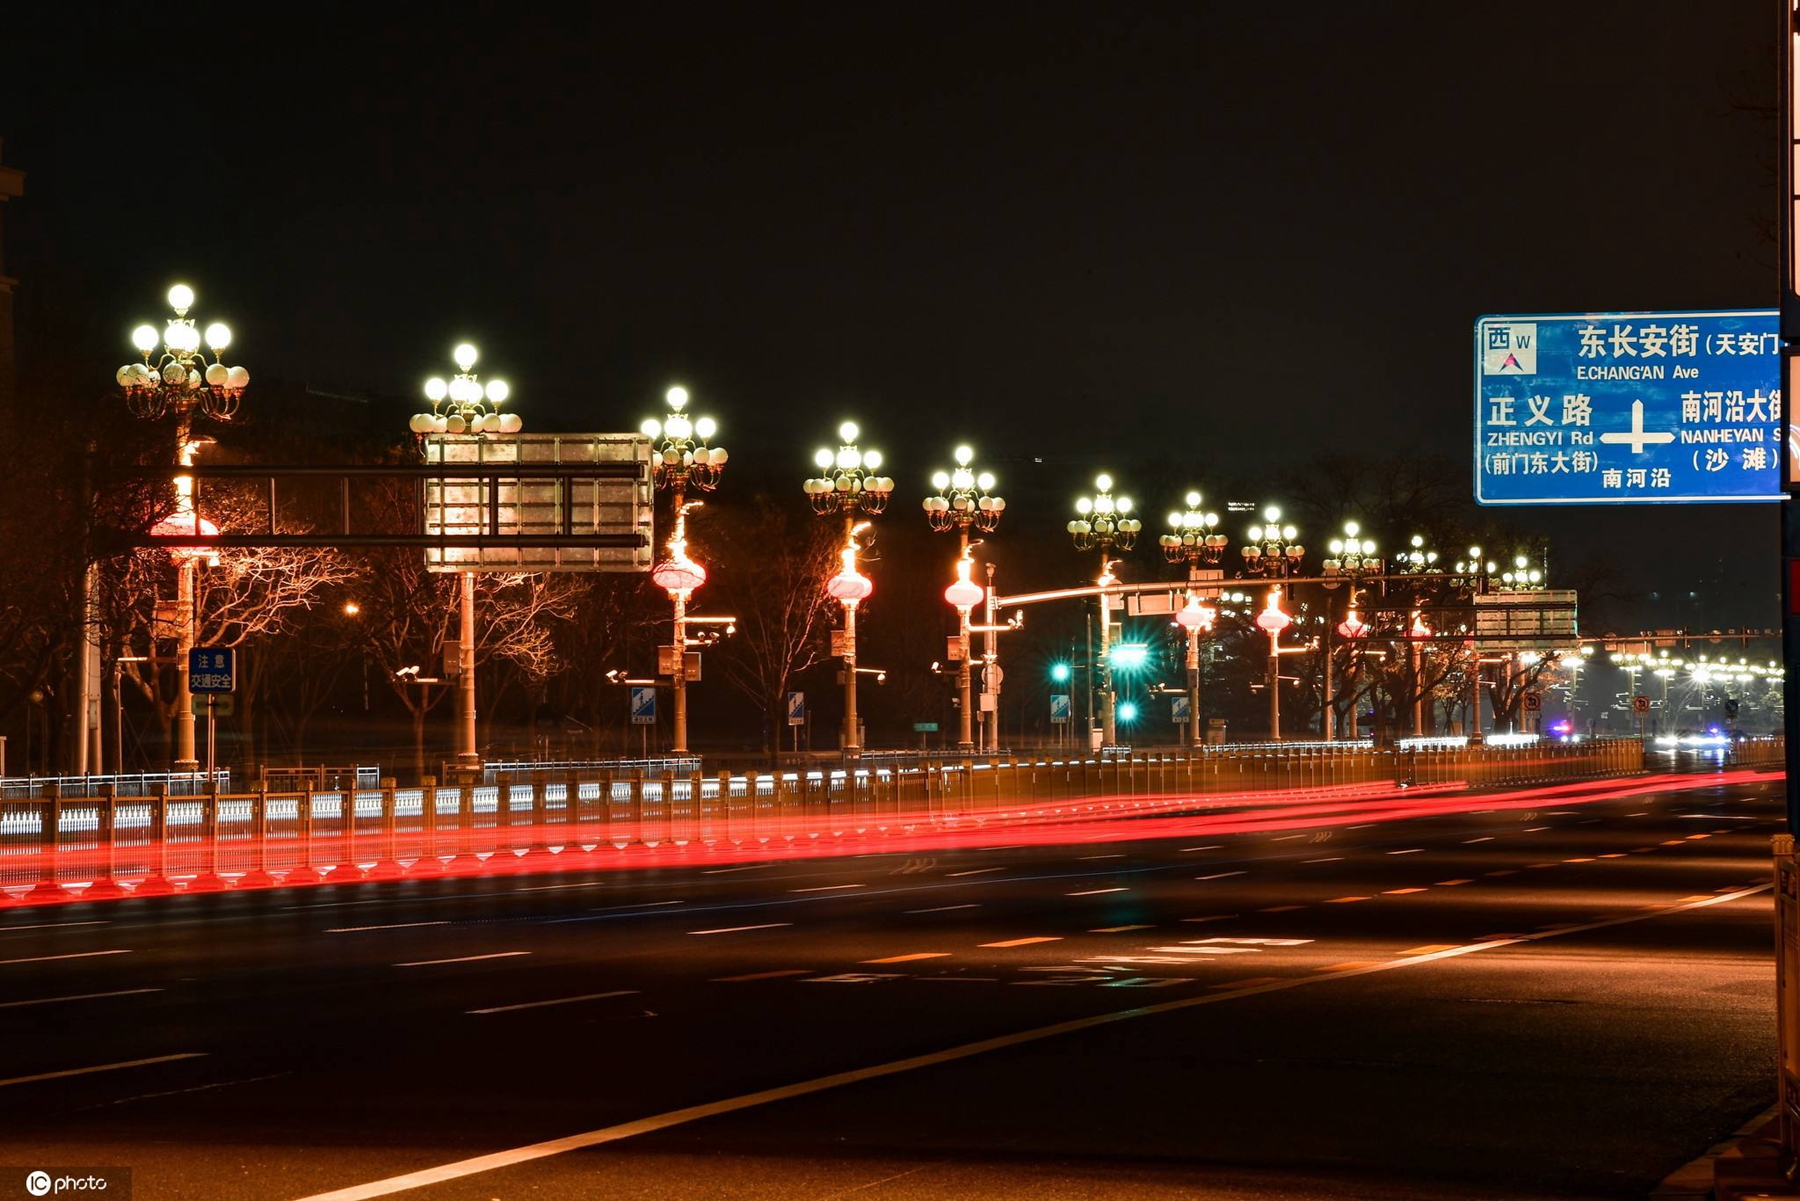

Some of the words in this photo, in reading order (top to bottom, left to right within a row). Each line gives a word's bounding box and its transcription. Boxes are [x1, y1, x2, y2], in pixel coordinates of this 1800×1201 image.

[1488, 327, 1511, 350] 西
[1516, 335, 1530, 349] W
[1578, 324, 1699, 358] 东长安街
[1672, 365, 1699, 379] Ave
[1487, 393, 1593, 427] 正义路
[1487, 432, 1562, 446] ZHENGYI
[1571, 431, 1594, 445] Rd
[1681, 428, 1764, 444] NANHEYAN
[1485, 450, 1598, 475] (前门东大街)
[1602, 468, 1672, 488] 南河沿
[198, 654, 225, 668] 注意
[191, 674, 231, 688] 交通安全
